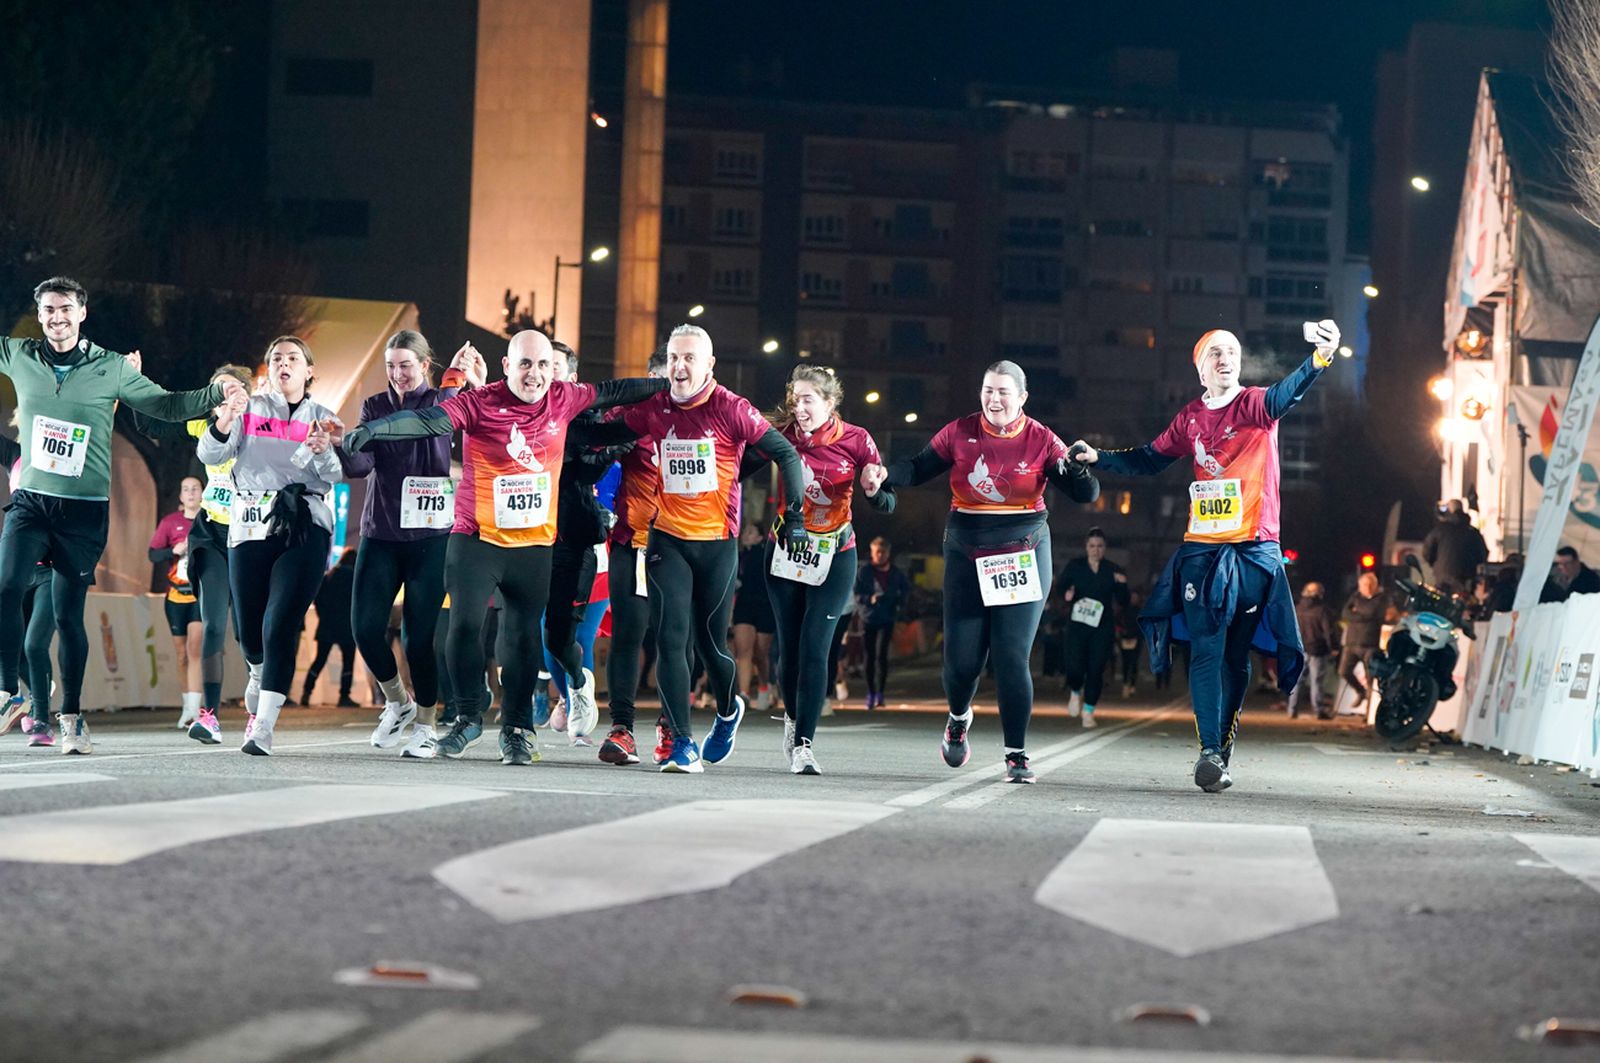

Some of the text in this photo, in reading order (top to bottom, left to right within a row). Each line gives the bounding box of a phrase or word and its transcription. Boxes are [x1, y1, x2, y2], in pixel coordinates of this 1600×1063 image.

[42, 436, 74, 458] 7061
[517, 450, 532, 464] 43
[669, 459, 706, 475] 6998
[805, 484, 820, 499] 43
[976, 480, 993, 494] 43
[416, 495, 445, 511] 1713
[507, 493, 542, 510] 4375
[1200, 498, 1232, 515] 6402
[787, 550, 820, 568] 1694
[991, 570, 1028, 589] 1693
